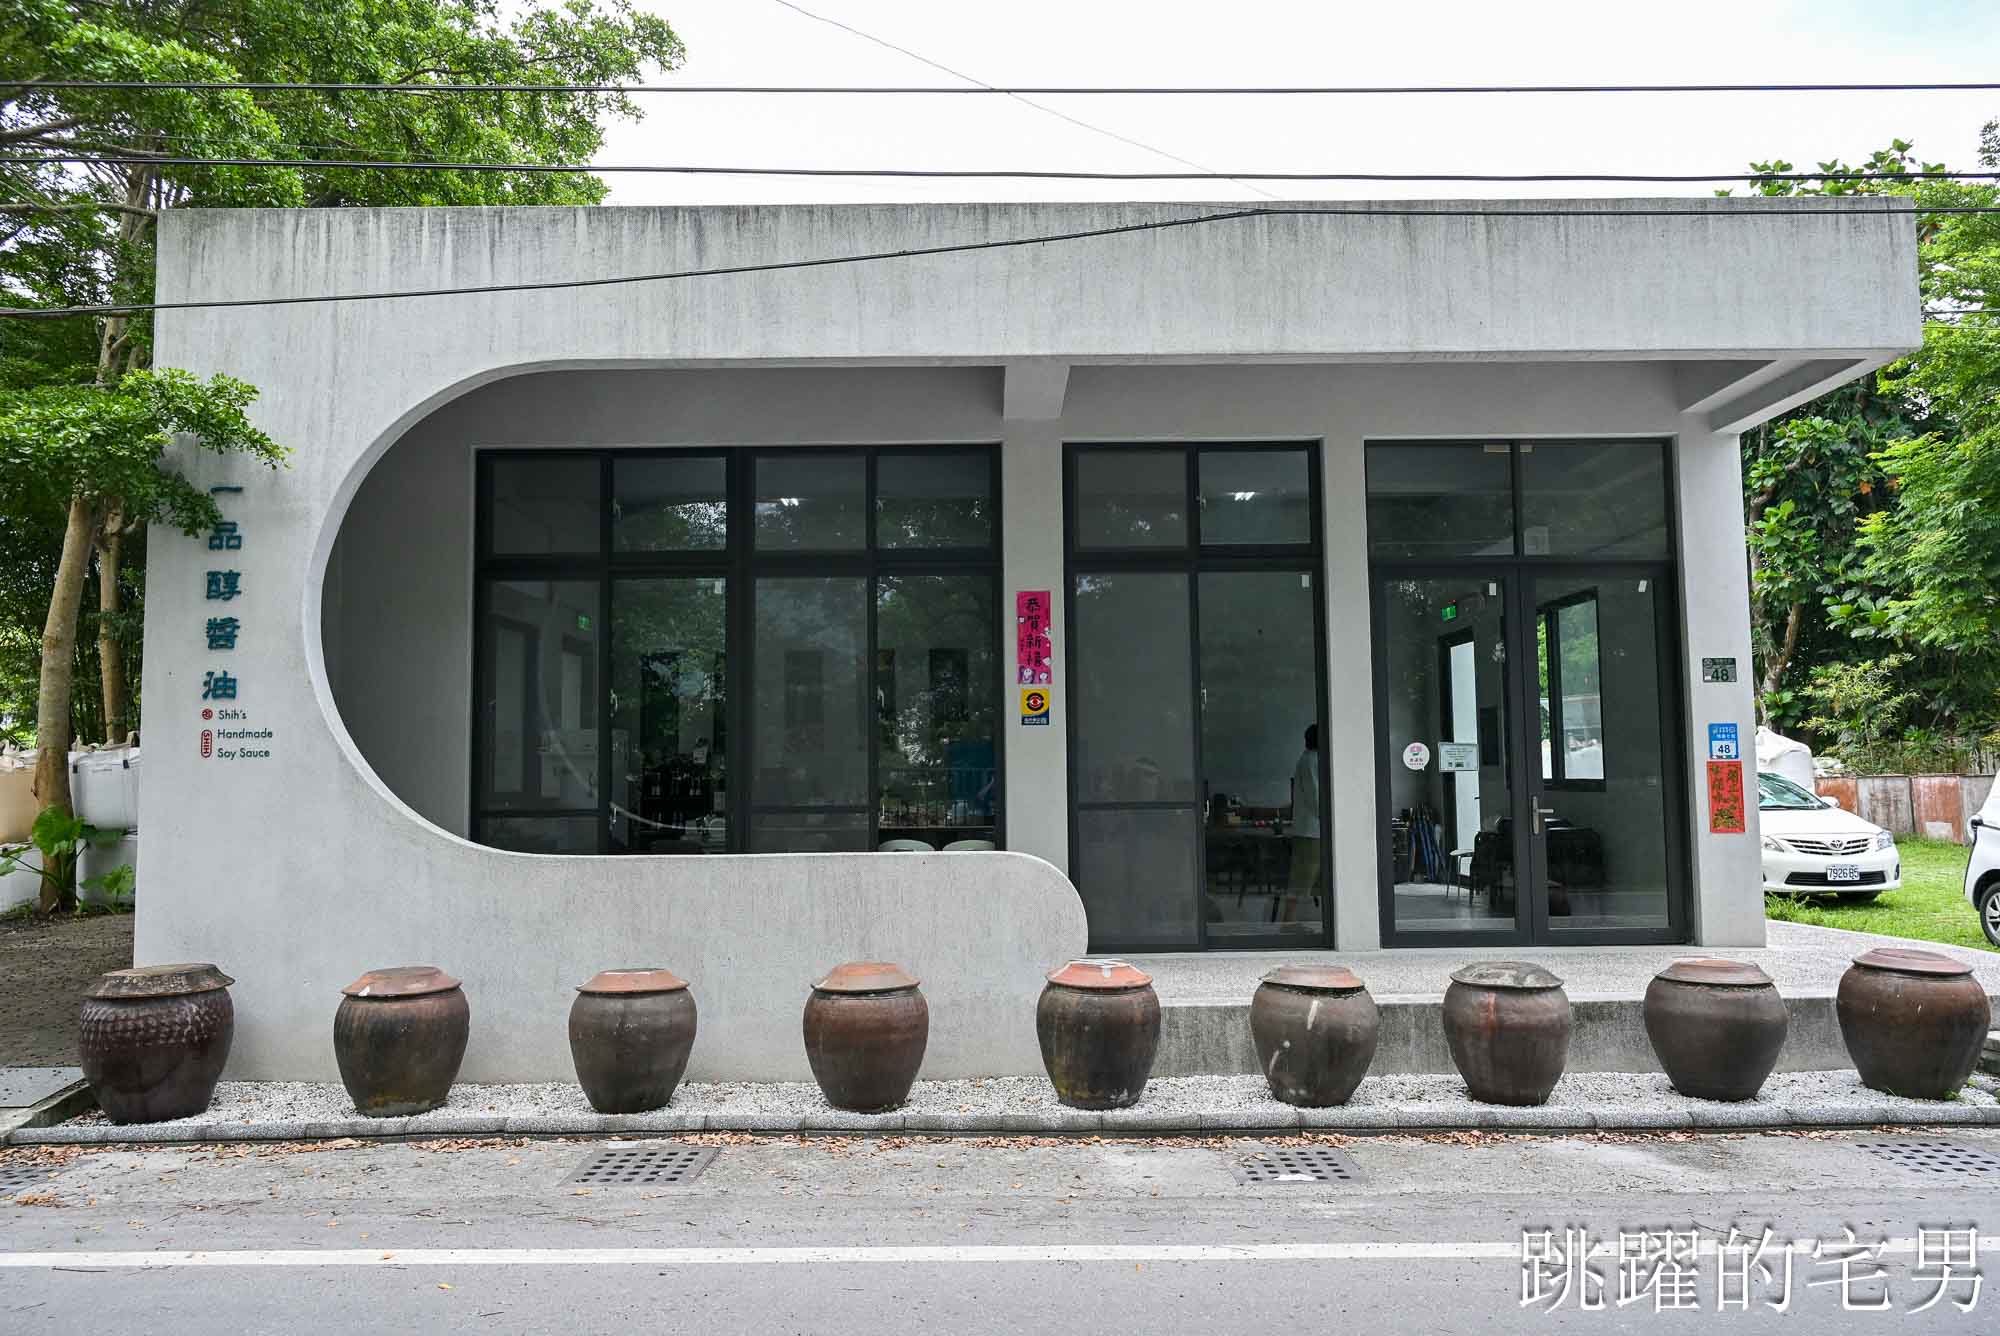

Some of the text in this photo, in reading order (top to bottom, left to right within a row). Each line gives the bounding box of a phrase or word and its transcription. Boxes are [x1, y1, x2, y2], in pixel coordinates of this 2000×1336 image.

[202, 486, 243, 699] 一品醇醬油
[1711, 668, 1729, 681] 48
[218, 710, 247, 720] Shih's
[217, 728, 273, 739] Handmade
[217, 748, 270, 760] Soy Sauce
[1718, 744, 1731, 754] 48
